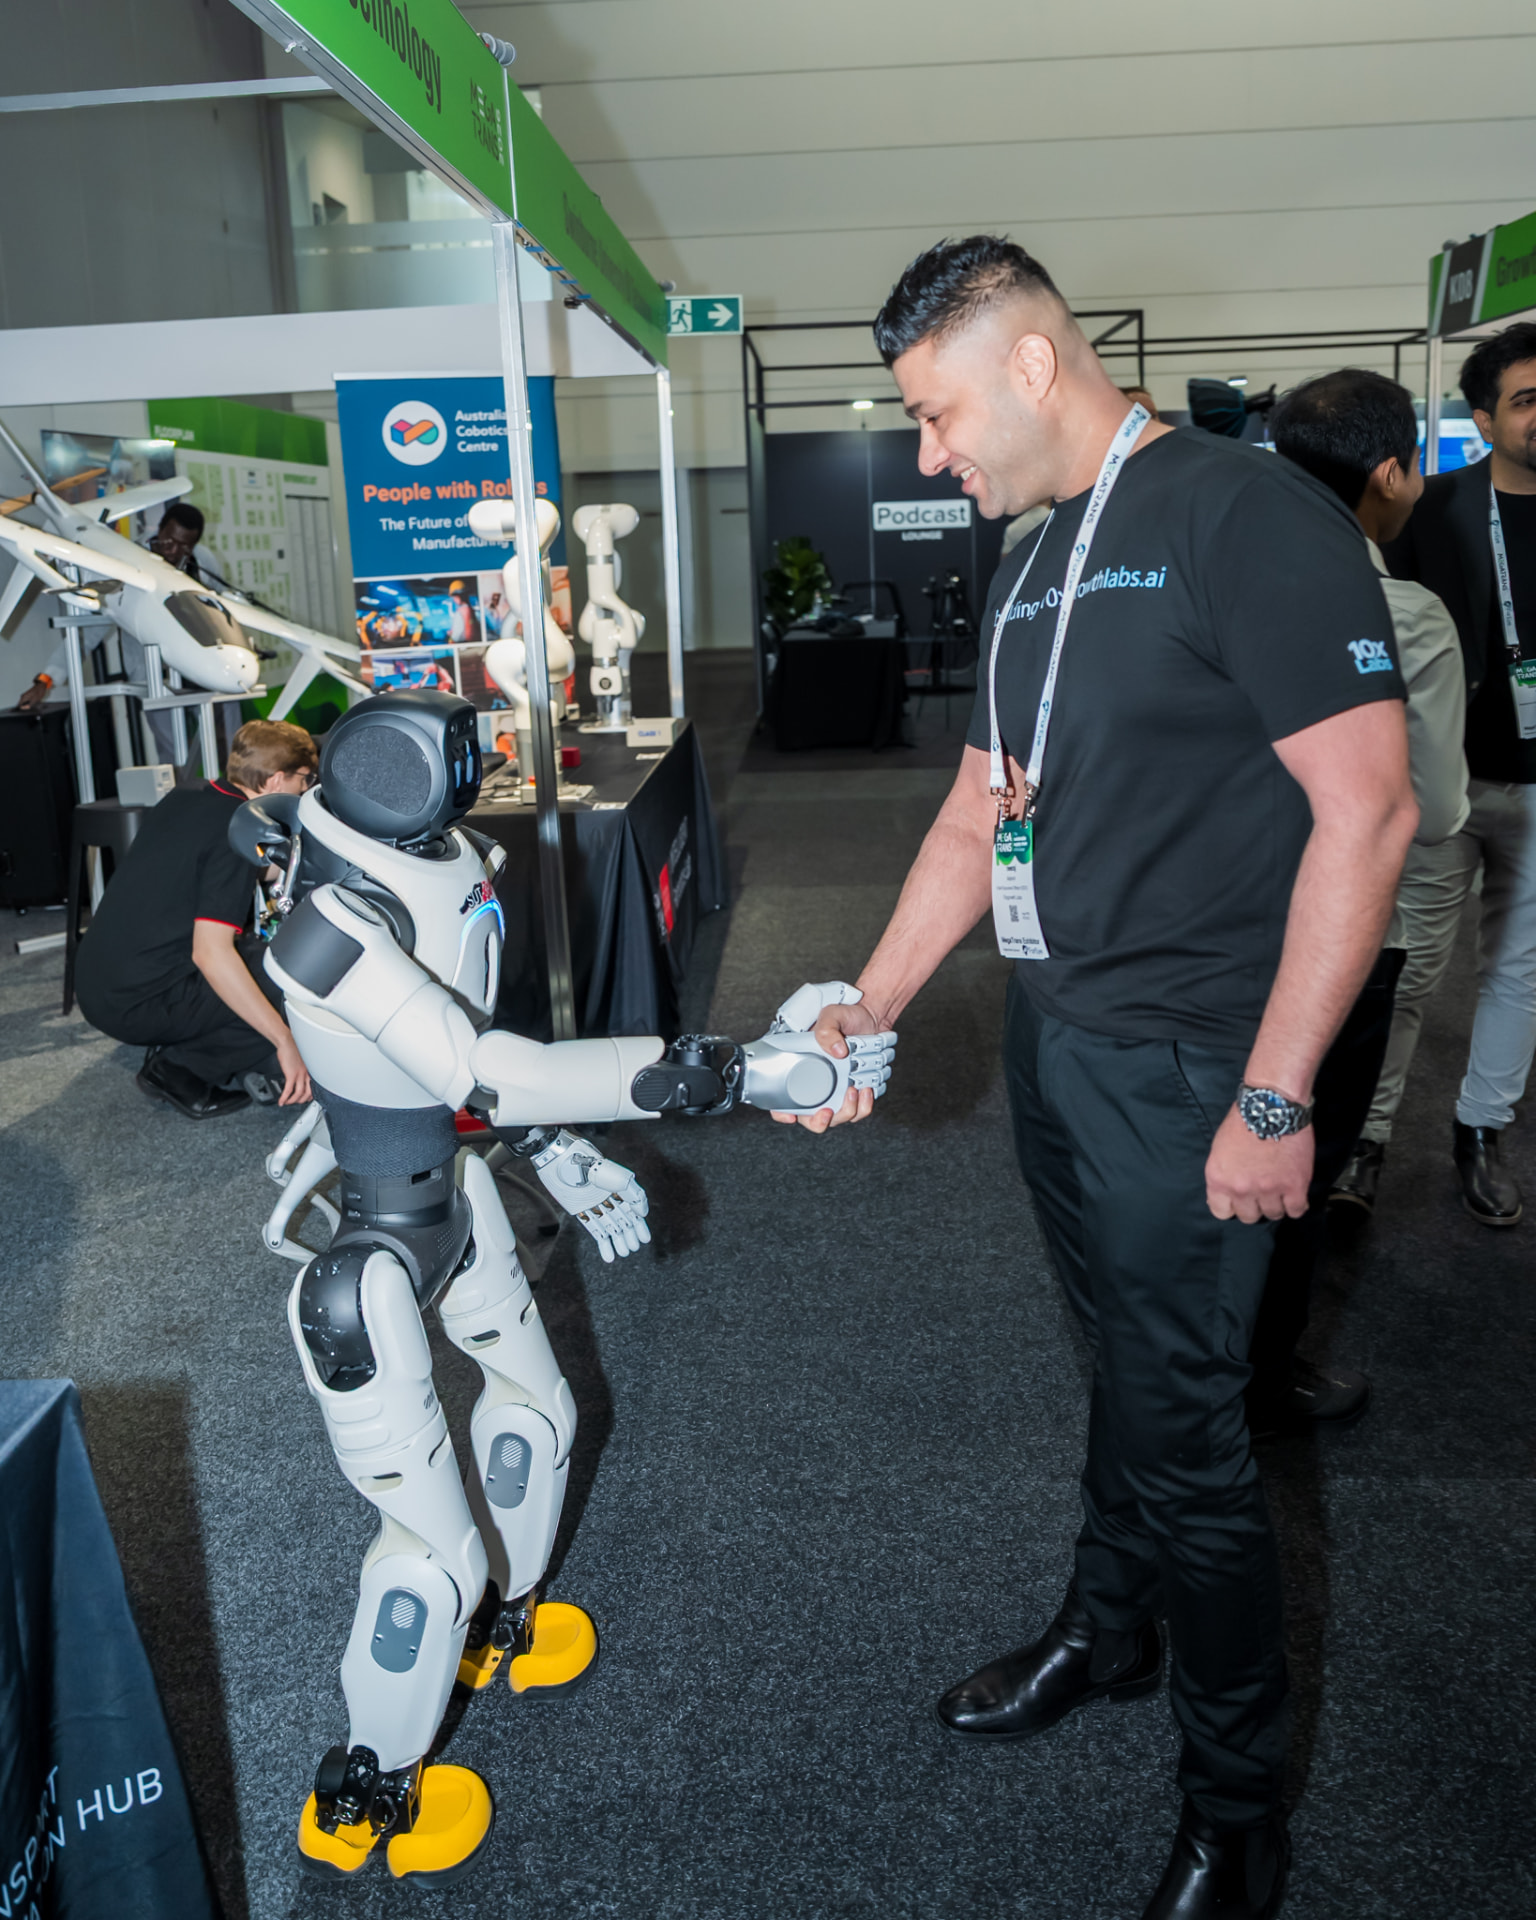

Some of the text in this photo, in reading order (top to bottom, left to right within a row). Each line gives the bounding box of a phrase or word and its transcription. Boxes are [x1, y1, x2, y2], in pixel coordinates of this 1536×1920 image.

[457, 440, 499, 452] Centre
[363, 482, 432, 505] People
[436, 480, 477, 498] with
[1087, 453, 1120, 524] MEGATRANS
[379, 514, 469, 531] The Future of
[877, 506, 967, 525] Podcast
[1347, 638, 1389, 660] 10x
[1354, 657, 1394, 674] Labs
[996, 831, 1012, 843] MEGA
[76, 1767, 163, 1831] HUB
